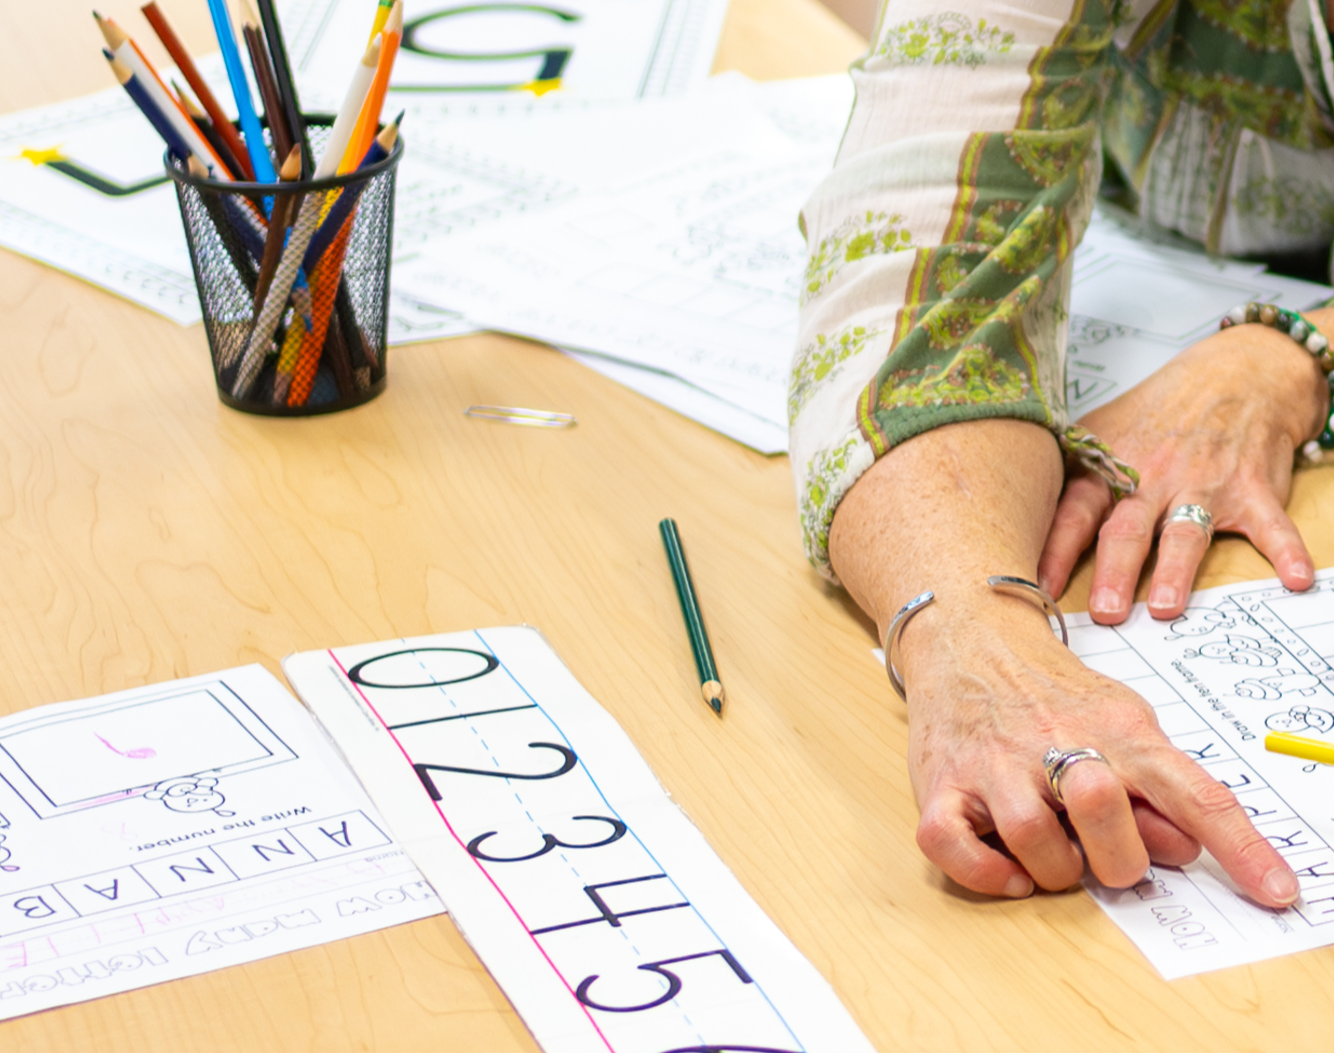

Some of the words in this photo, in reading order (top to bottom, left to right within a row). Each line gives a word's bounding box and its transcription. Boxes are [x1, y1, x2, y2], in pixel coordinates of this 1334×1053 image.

[389, 3, 583, 94] 5
[1194, 682, 1212, 697] ten
[1207, 698, 1226, 711] the
[1230, 720, 1256, 741] Draw
[413, 741, 578, 801] 2
[223, 819, 256, 831] the
[261, 806, 312, 822] Write
[130, 827, 216, 852] number.
[467, 815, 627, 862] 3
[529, 873, 691, 937] 4
[575, 949, 753, 1013] 5
